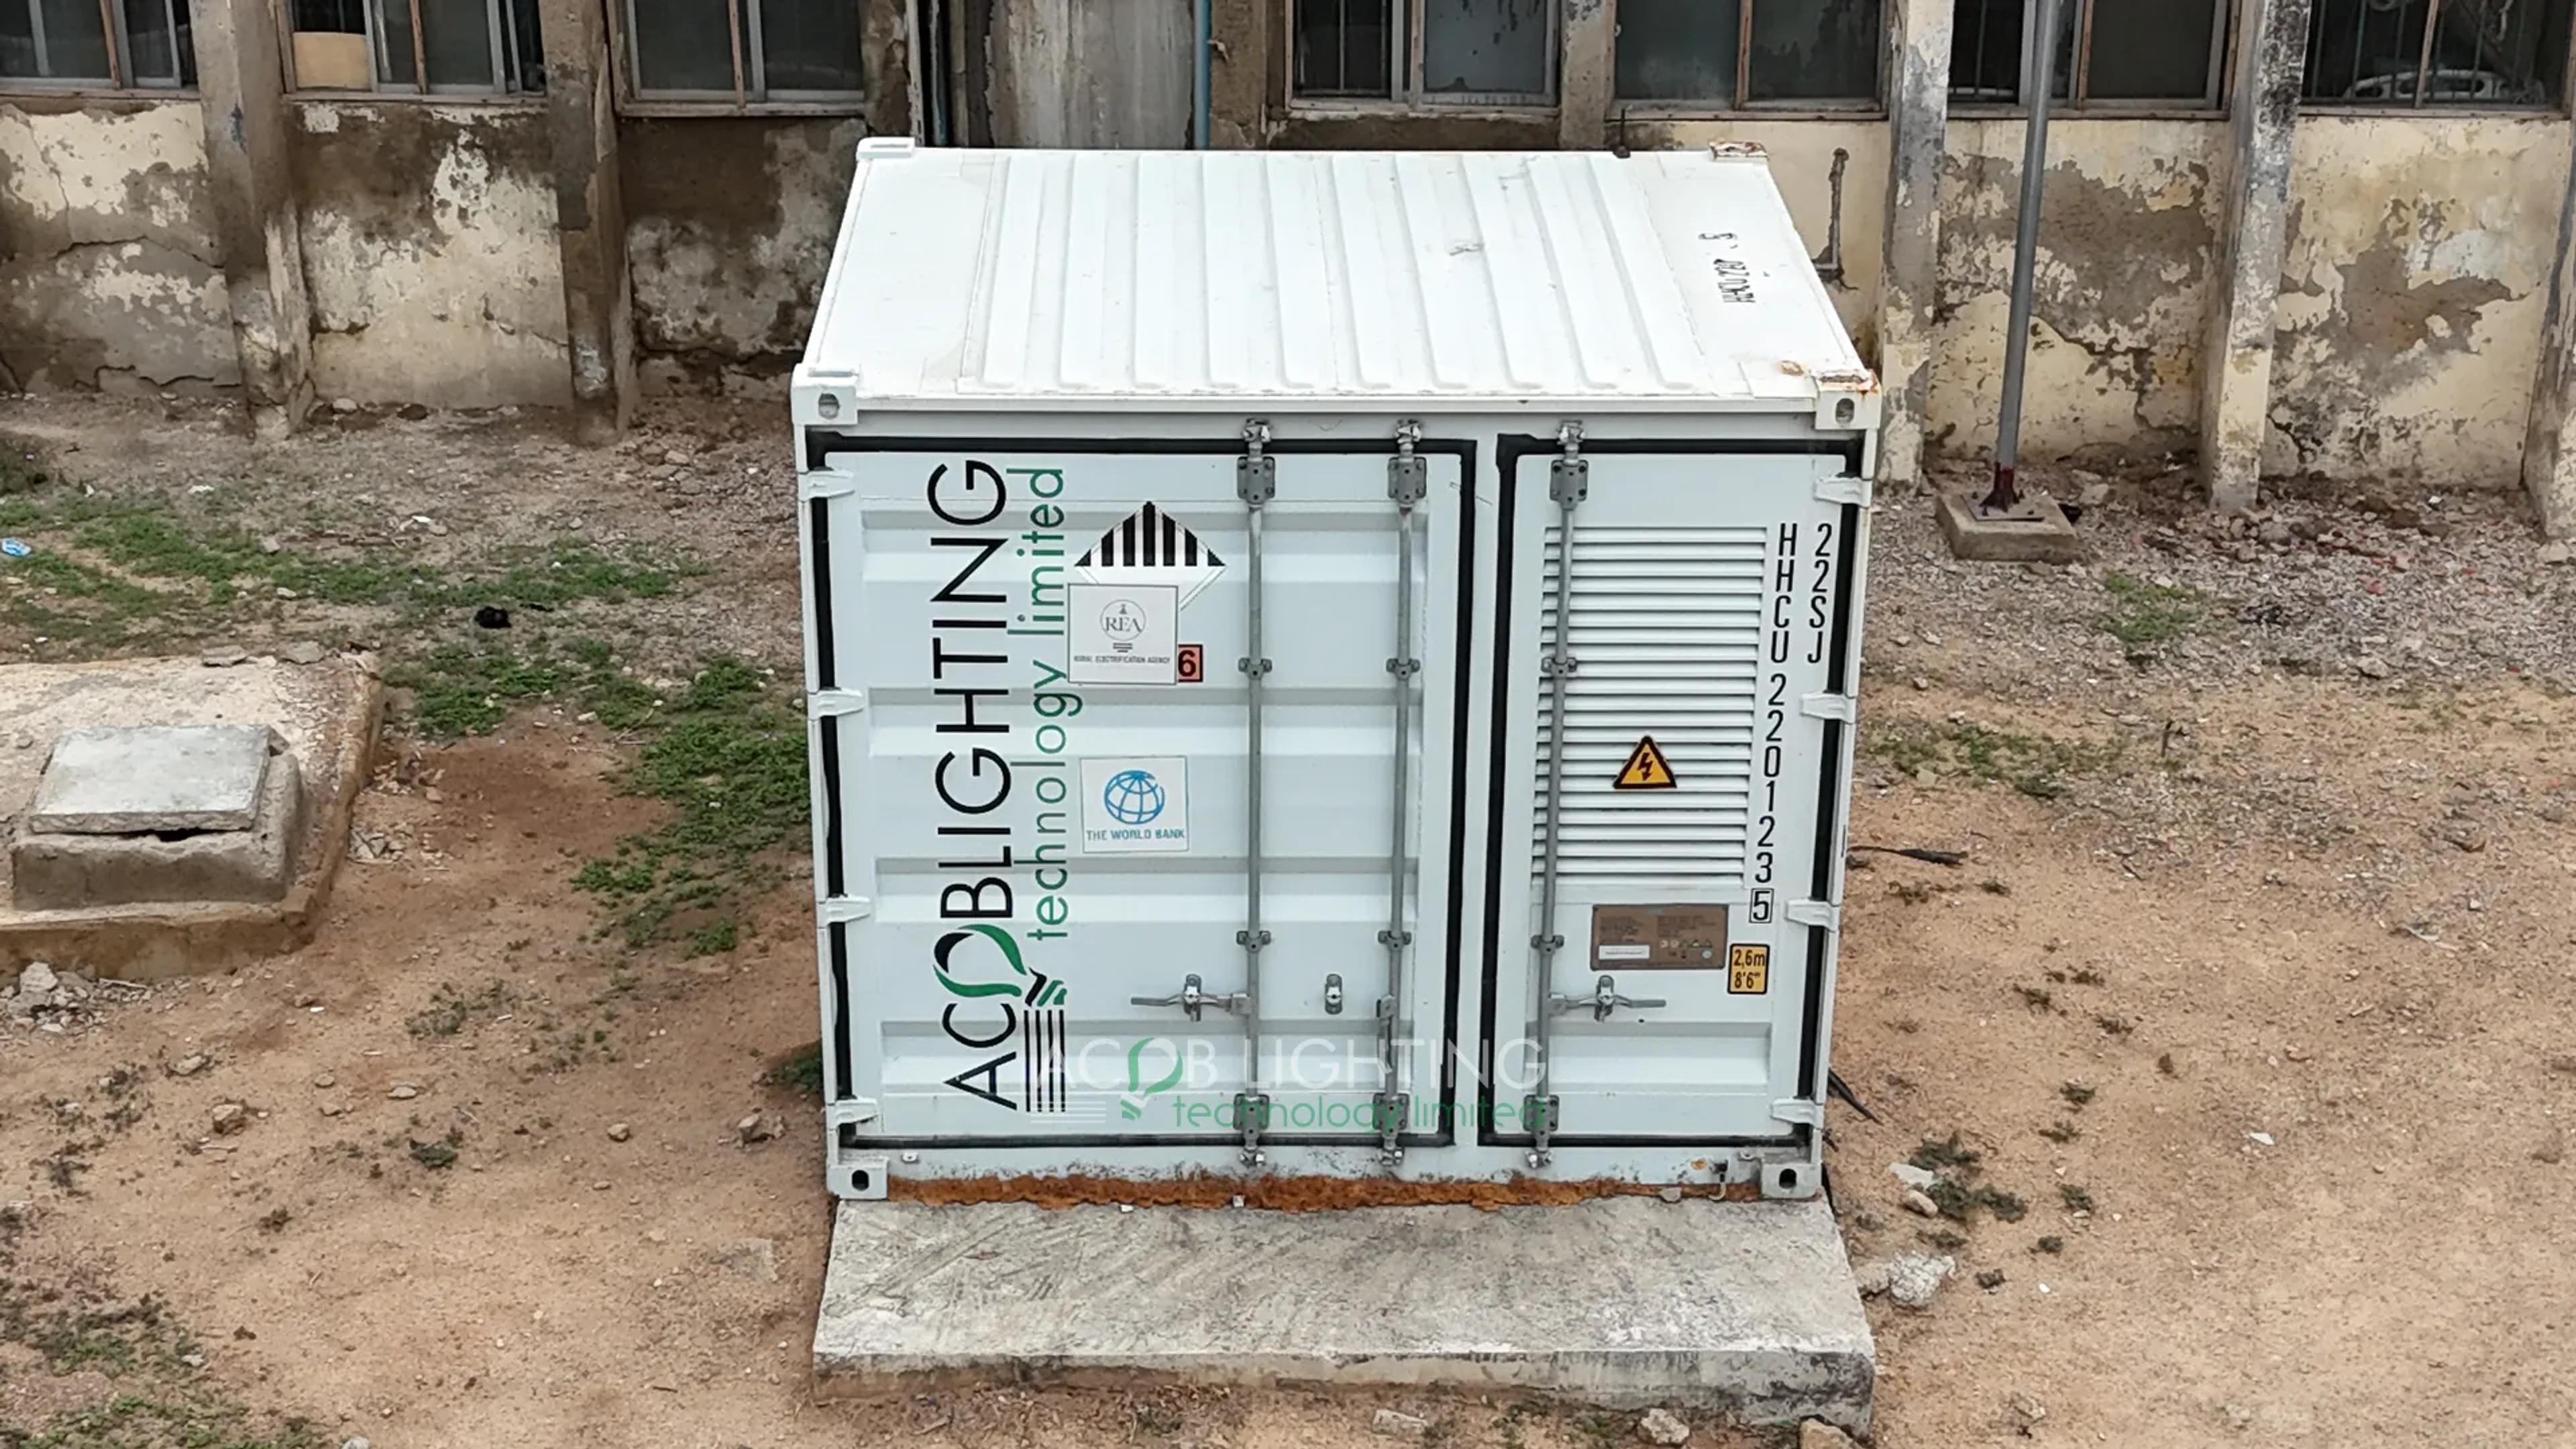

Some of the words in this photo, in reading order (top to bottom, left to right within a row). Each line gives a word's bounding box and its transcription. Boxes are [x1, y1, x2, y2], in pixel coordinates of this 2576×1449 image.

[1006, 466, 1065, 635] limited
[1770, 523, 1798, 663] HHCU
[1105, 616, 1143, 633] REA
[1178, 649, 1197, 678] 6
[1010, 659, 1082, 941] technology
[1086, 830, 1108, 841] THE
[1110, 829, 1152, 840] WORLD
[1155, 828, 1185, 839] BANK
[1753, 890, 1771, 920] 5
